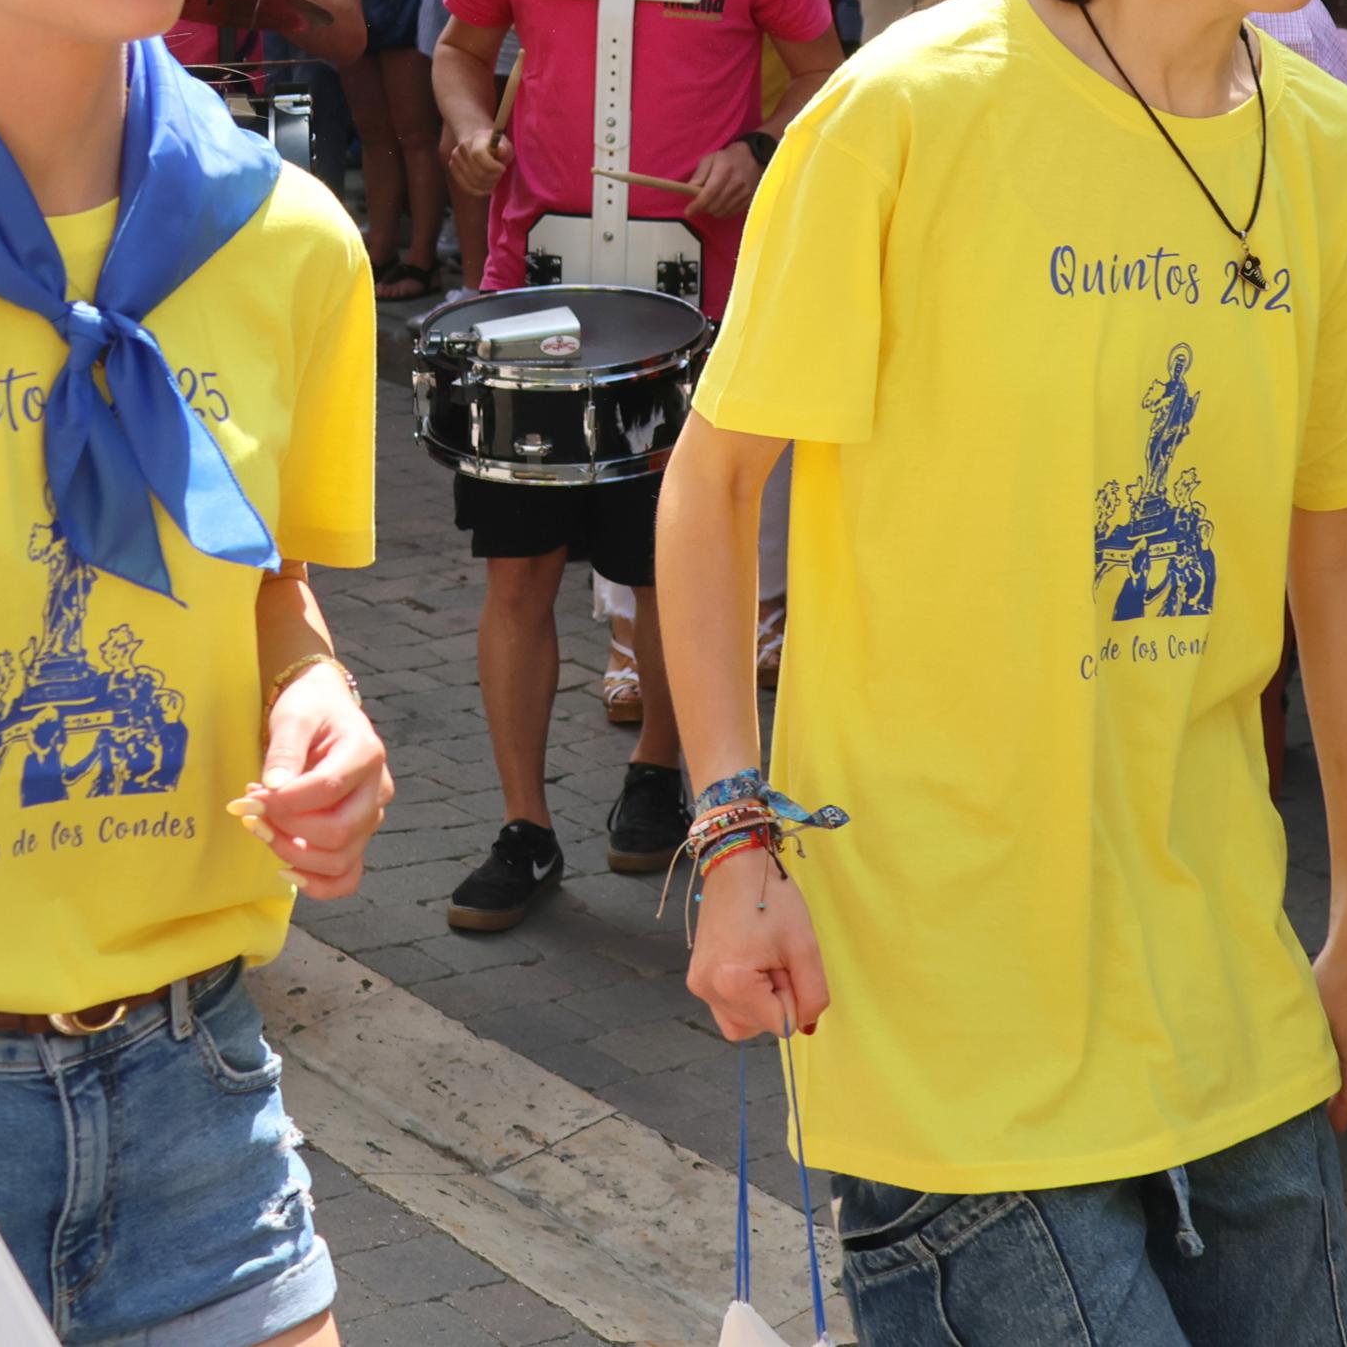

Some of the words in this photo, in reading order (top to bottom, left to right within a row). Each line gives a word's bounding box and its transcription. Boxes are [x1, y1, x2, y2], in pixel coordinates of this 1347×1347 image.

[1050, 245, 1201, 305] Quintos
[176, 367, 231, 423] 25
[1100, 637, 1120, 660] de
[1132, 635, 1158, 662] los
[1167, 634, 1210, 659] Con
[12, 827, 38, 858] de
[51, 822, 84, 850] los
[98, 811, 197, 843] Condes
